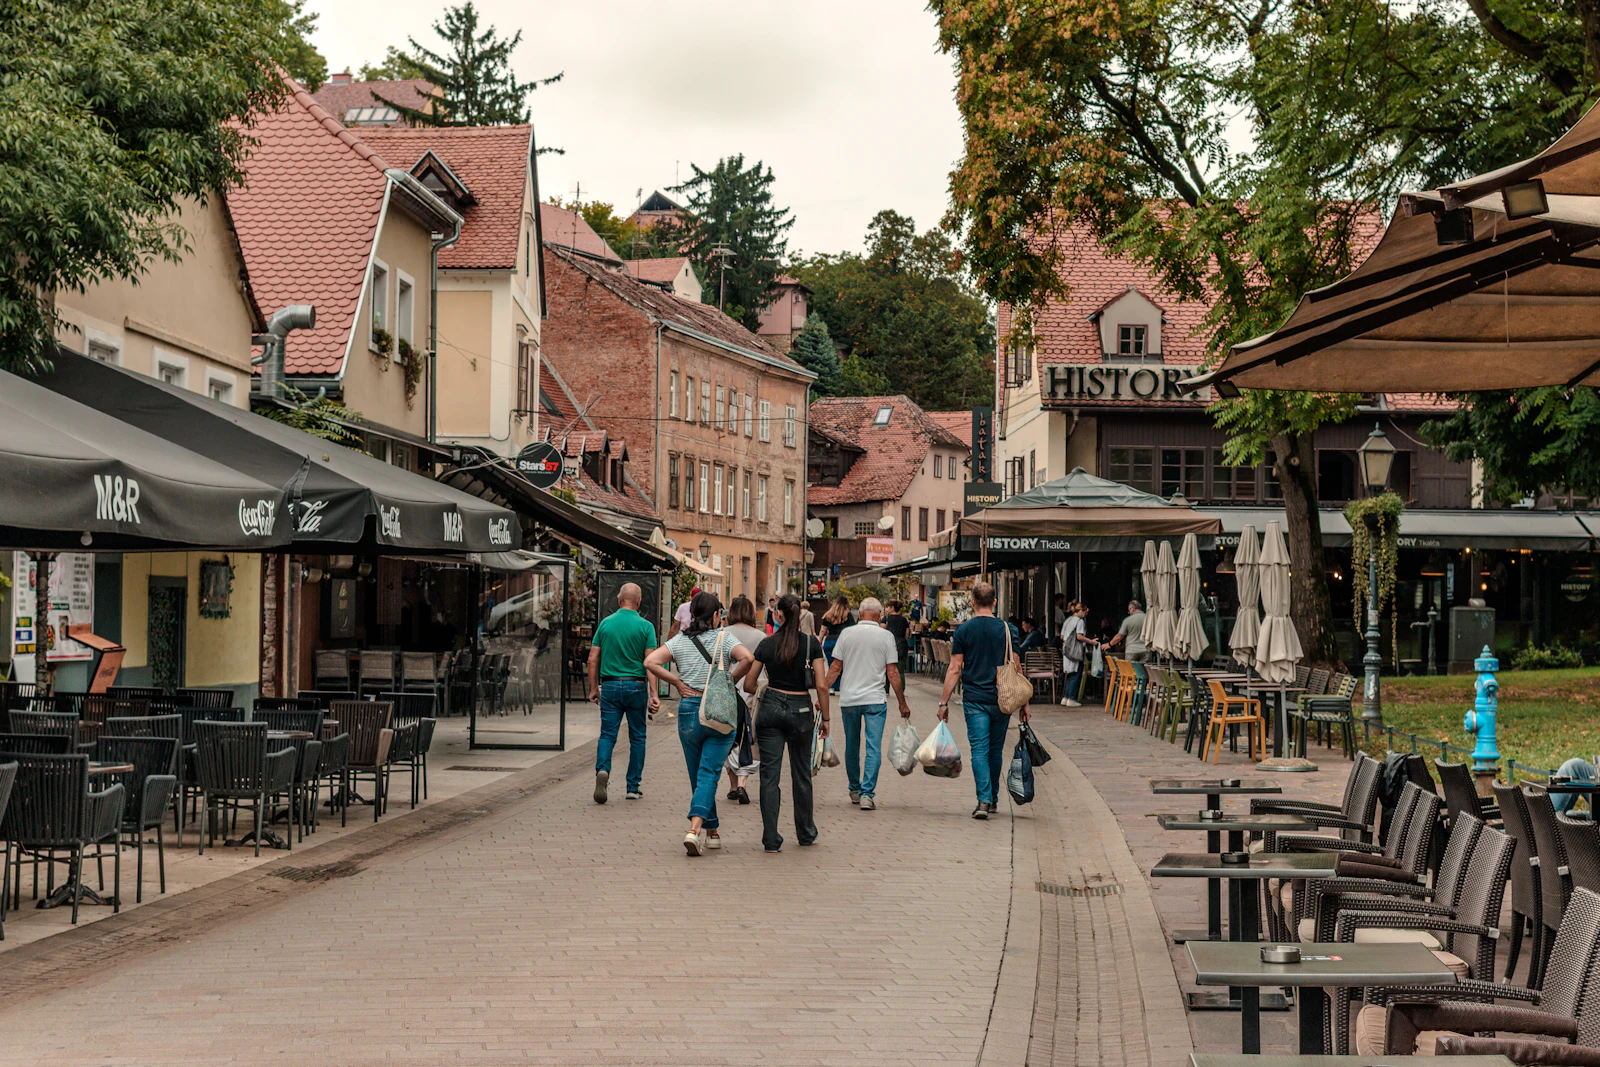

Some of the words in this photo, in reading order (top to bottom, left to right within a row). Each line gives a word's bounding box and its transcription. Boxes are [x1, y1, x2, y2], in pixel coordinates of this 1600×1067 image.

[94, 474, 141, 524] M&R
[967, 495, 1000, 503] HISTORY
[443, 512, 464, 543] M&R
[1040, 540, 1071, 550] Tkalča
[1215, 536, 1240, 545] STOR
